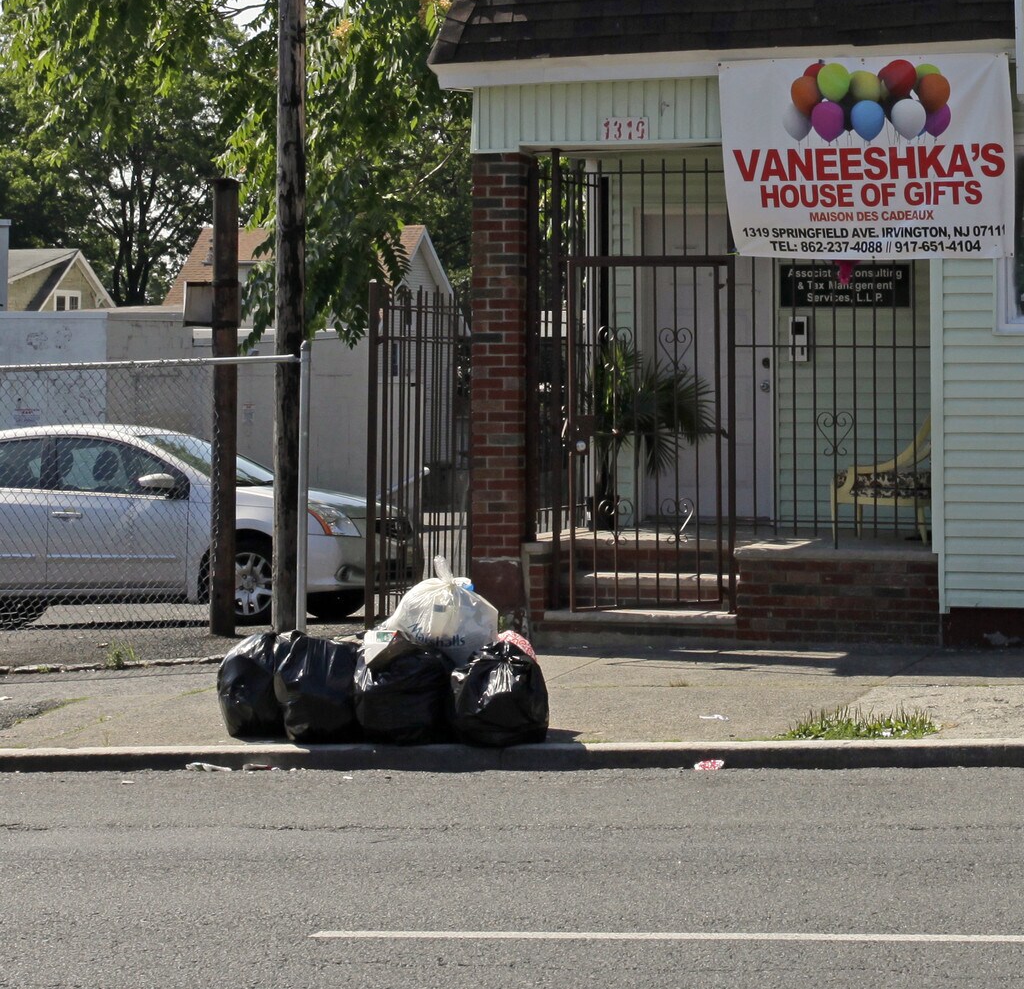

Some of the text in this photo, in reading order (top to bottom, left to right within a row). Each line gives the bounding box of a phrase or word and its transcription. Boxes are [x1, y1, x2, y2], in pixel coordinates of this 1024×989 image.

[603, 120, 645, 140] 1319
[733, 143, 1006, 182] VANEESHKA'S
[760, 180, 983, 208] HOUSE OF GIFTS
[809, 210, 934, 222] MAISON DES CADEAUX
[743, 224, 1006, 239] 1319 SPRINGFIELD AVE. IRVINGTON, NJ 07111
[770, 241, 798, 252] TEL:
[801, 241, 882, 253] 862-237-4088
[895, 240, 981, 253] 917-651-4104
[788, 268, 902, 279] Associat onsulting
[797, 281, 804, 290] &
[807, 281, 824, 290] Tax
[856, 293, 883, 302] L.LP.
